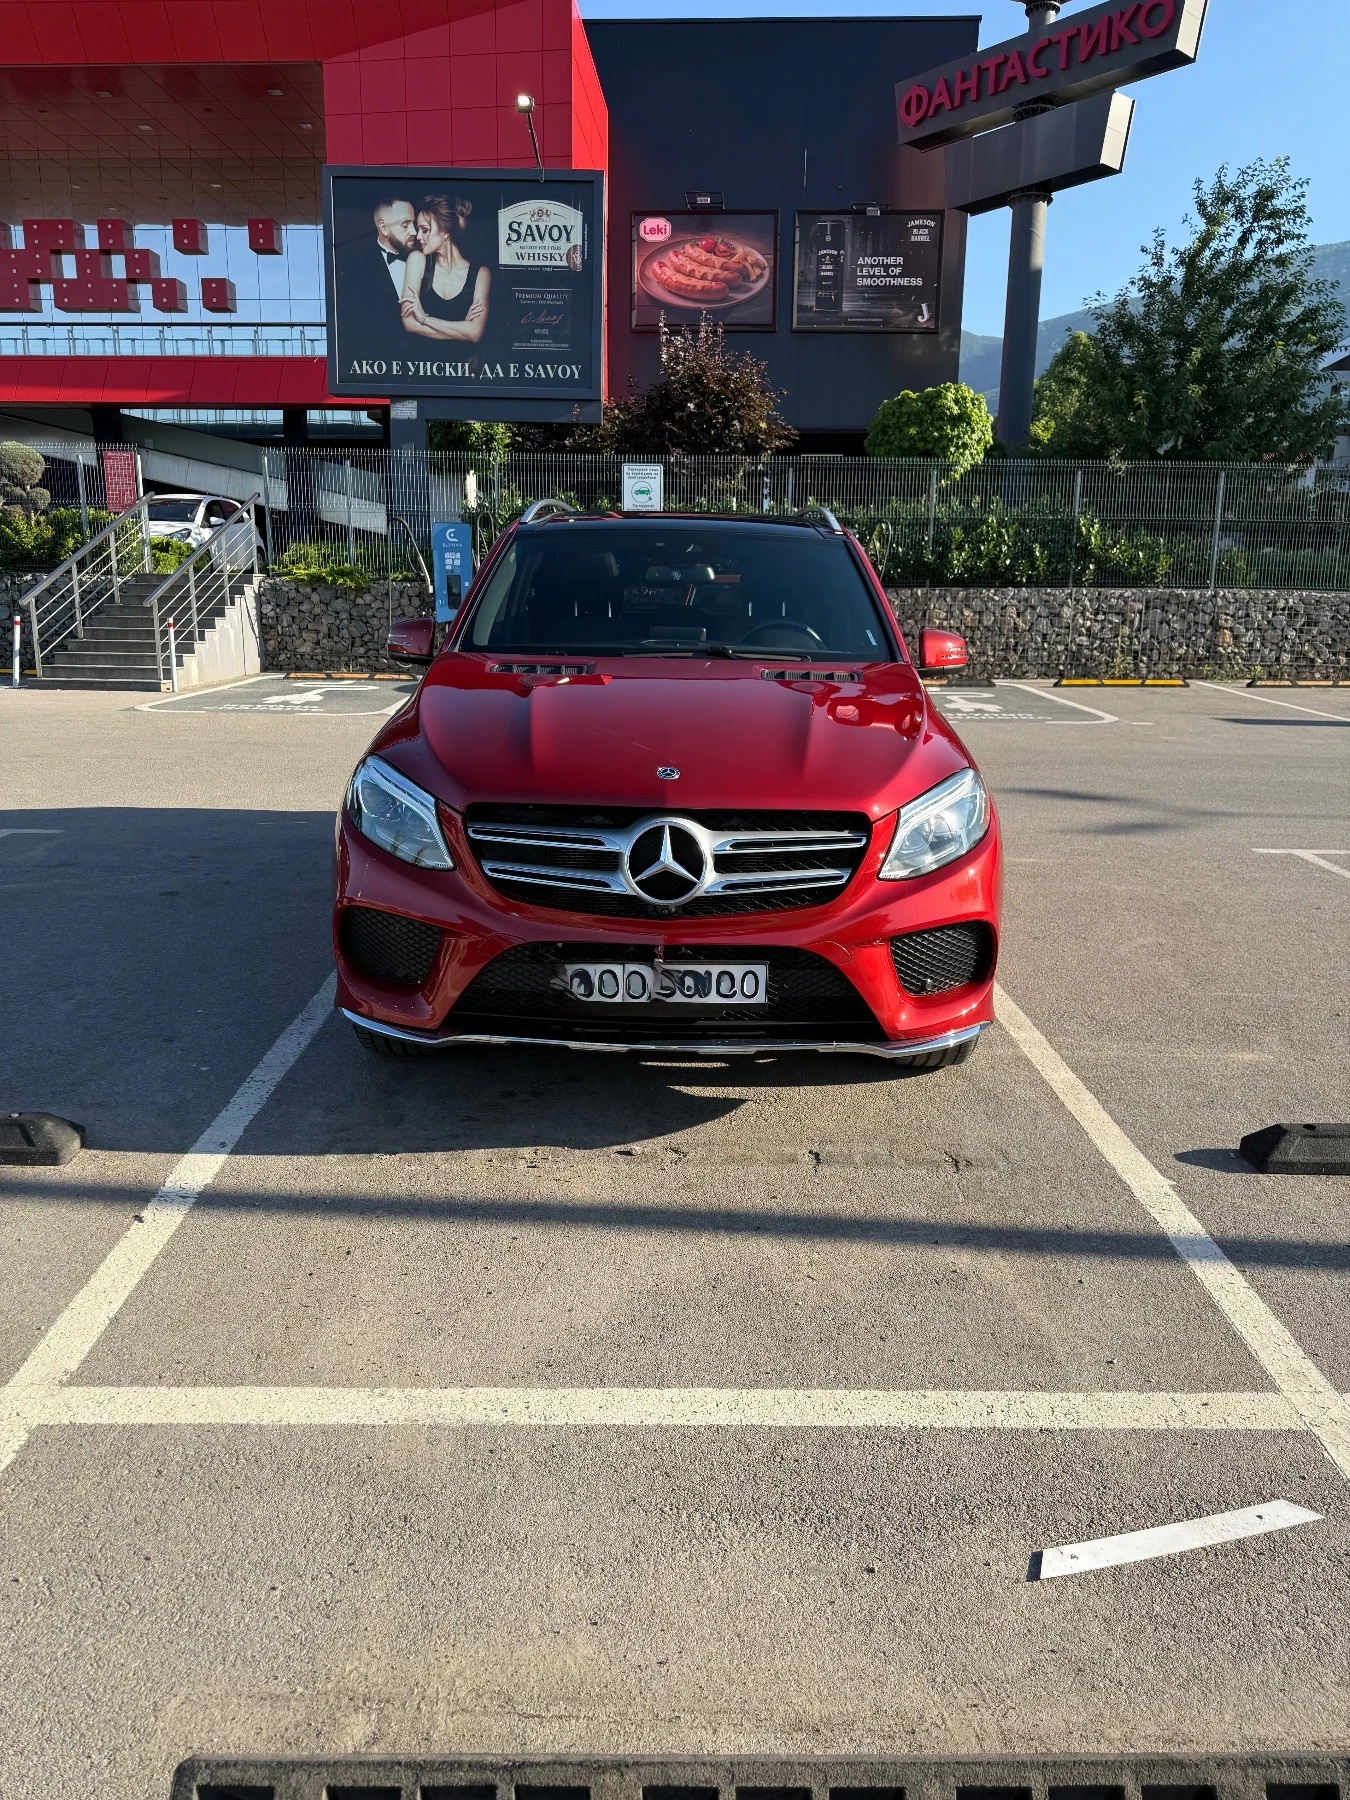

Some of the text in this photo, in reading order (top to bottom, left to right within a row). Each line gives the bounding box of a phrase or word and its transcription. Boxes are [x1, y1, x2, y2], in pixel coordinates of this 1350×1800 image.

[899, 0, 1176, 127] ФАНТАСТИКО
[907, 219, 937, 228] JAMESON
[505, 220, 575, 246] SAVOY
[643, 224, 667, 235] Leki
[515, 252, 566, 262] WHISKY
[857, 256, 904, 265] ANOTHER
[856, 267, 903, 276] LEVEL OF
[856, 277, 923, 286] SMOOTHNESS
[350, 360, 387, 375] АКО
[408, 361, 476, 380] УИСКИ,
[479, 362, 504, 380] ДА
[524, 363, 582, 380] SAVOY
